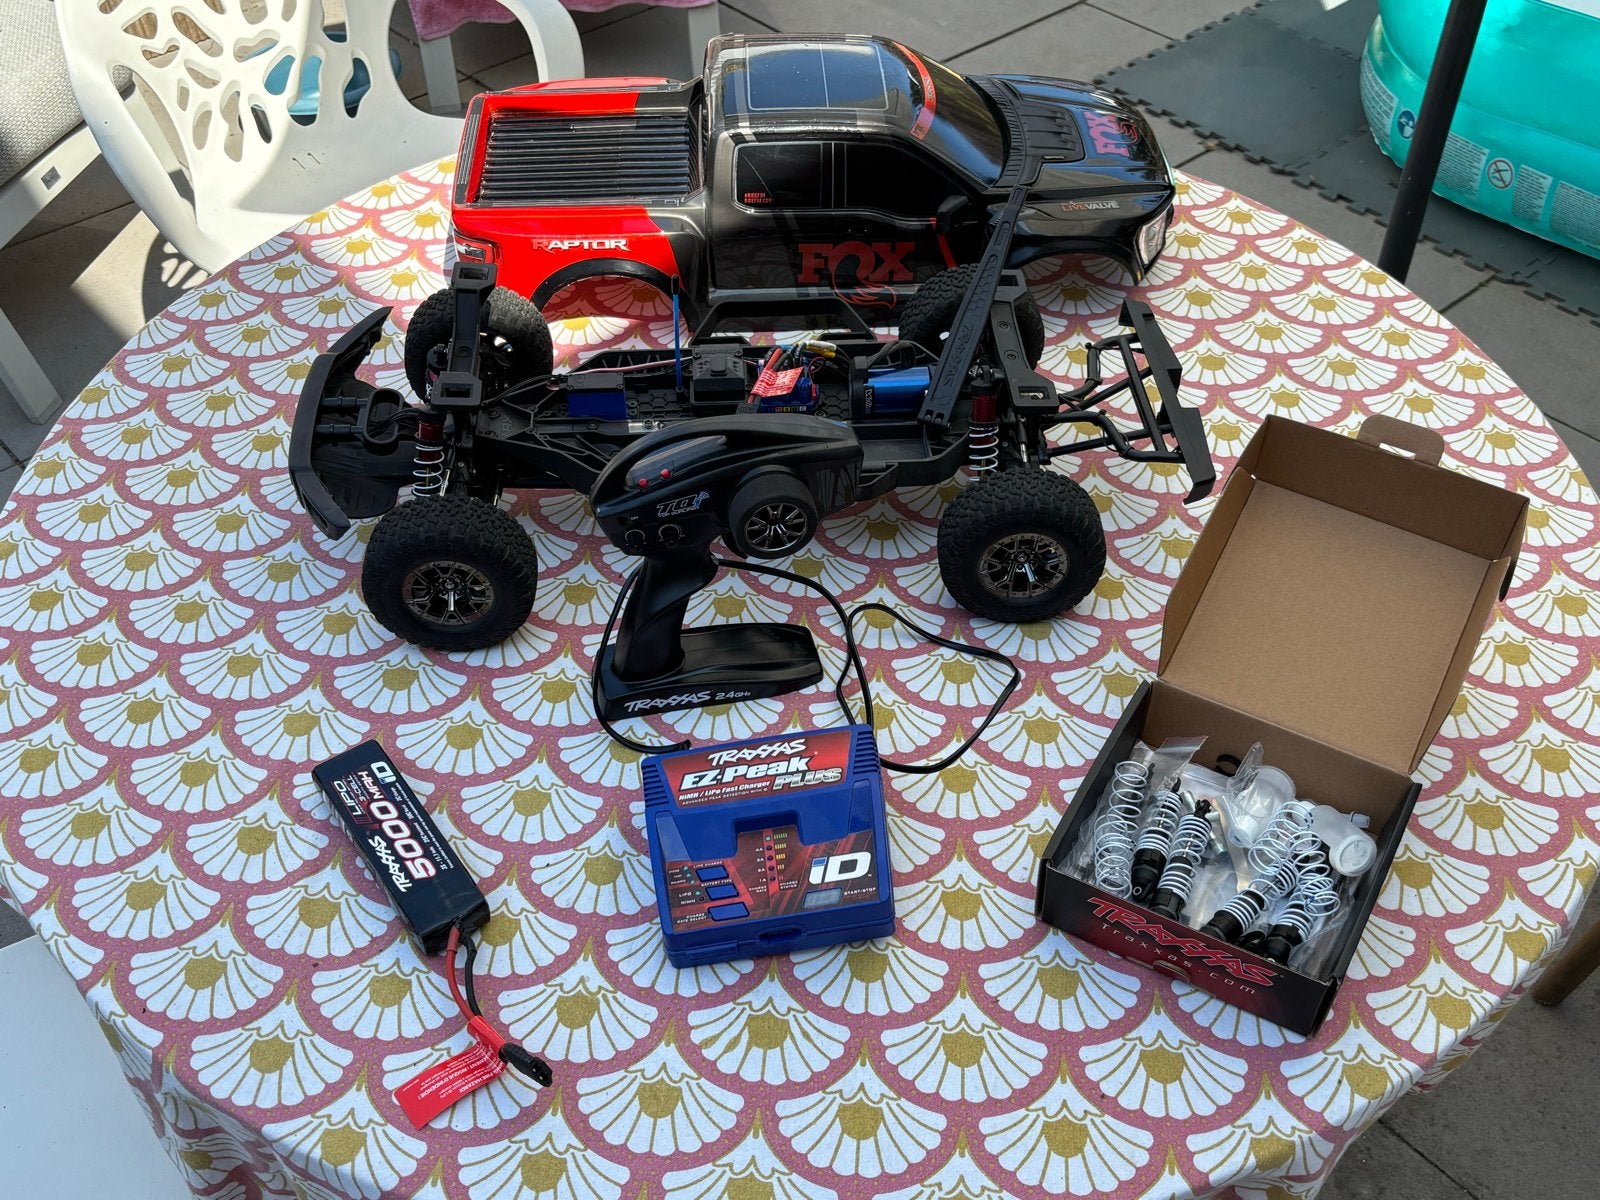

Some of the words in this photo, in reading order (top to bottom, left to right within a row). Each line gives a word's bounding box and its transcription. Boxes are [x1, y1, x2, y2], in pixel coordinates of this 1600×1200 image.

[532, 238, 631, 252] RAPTOR
[798, 240, 915, 286] FOX
[624, 690, 712, 712] TRAXXAS
[708, 738, 806, 766] TRAXXAS
[370, 761, 397, 784] iD
[680, 757, 811, 790] EZ-Peak
[722, 785, 739, 793] Fast
[739, 780, 770, 792] Charger
[773, 768, 842, 790] PLUS
[370, 800, 437, 880] 5000
[368, 835, 413, 892] TRAXXAS
[809, 852, 871, 885] iD
[1088, 896, 1278, 987] TRAXXAS
